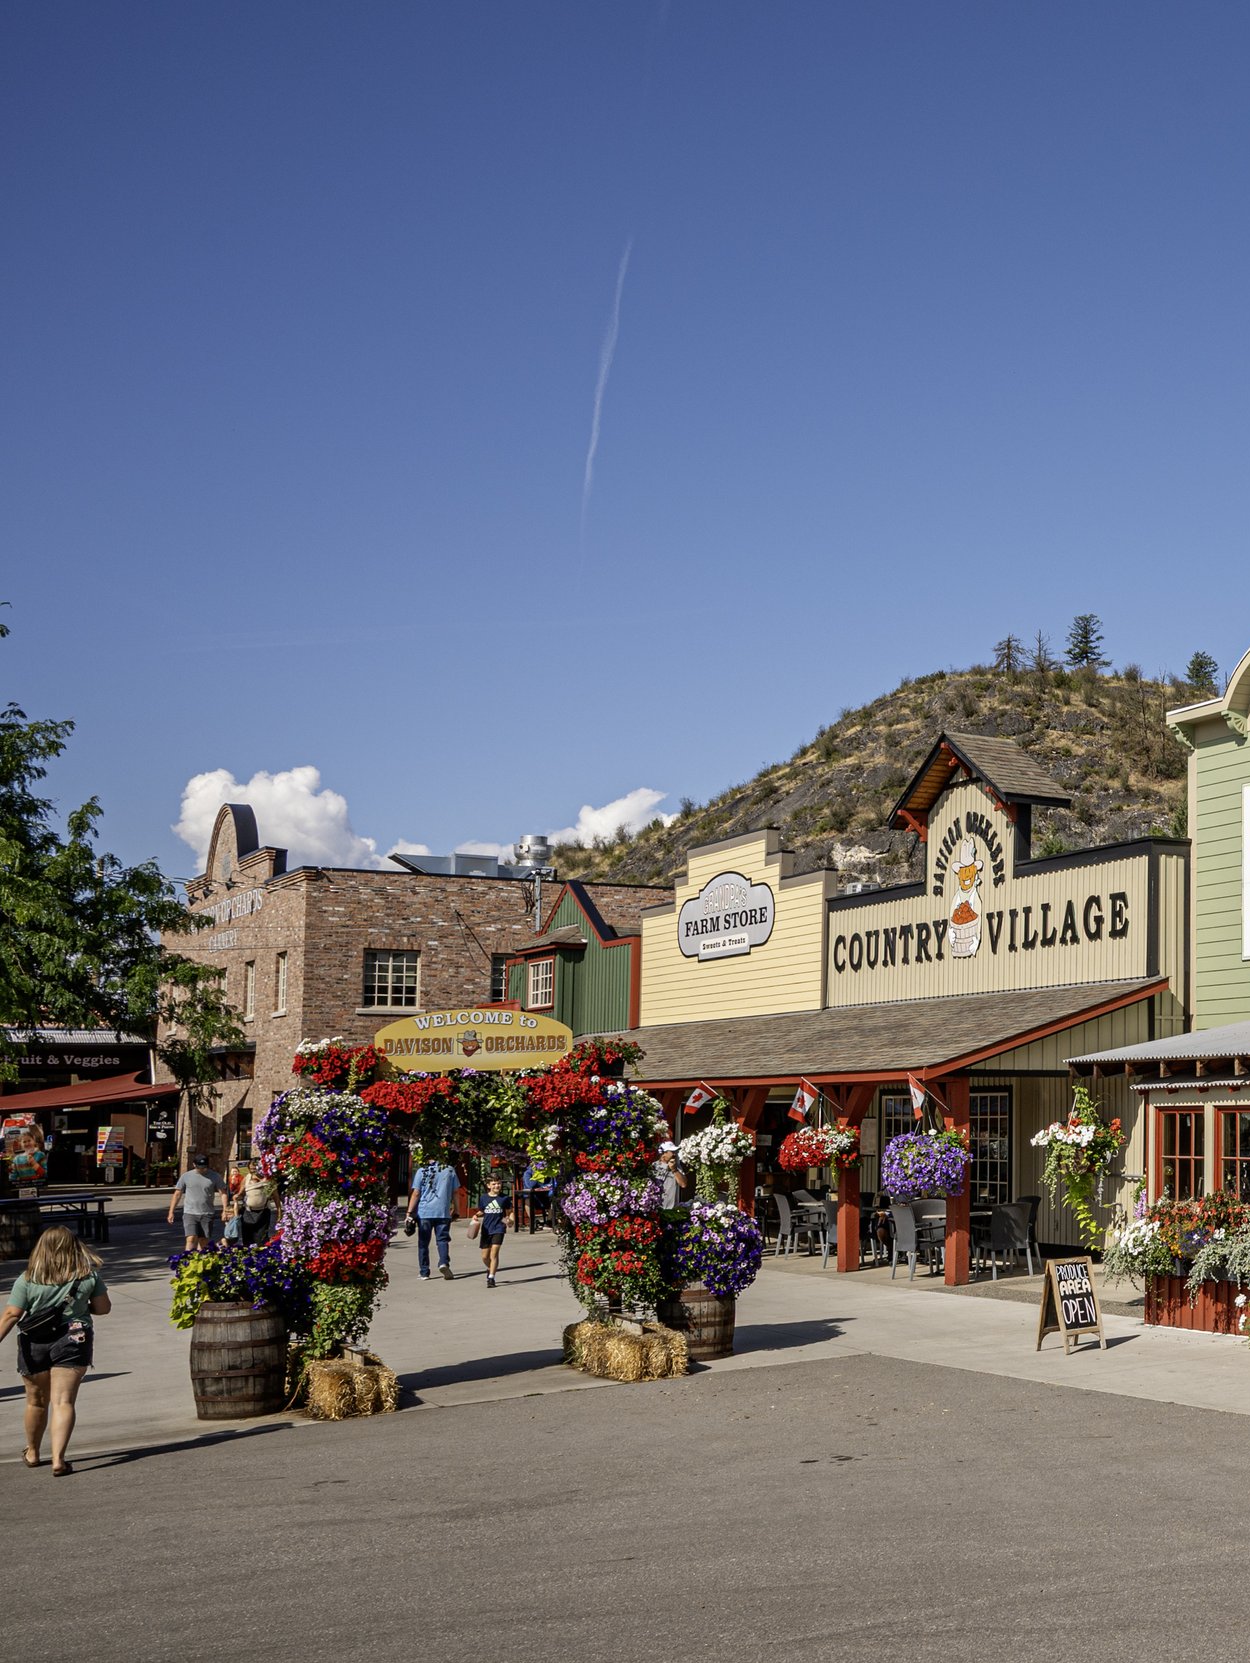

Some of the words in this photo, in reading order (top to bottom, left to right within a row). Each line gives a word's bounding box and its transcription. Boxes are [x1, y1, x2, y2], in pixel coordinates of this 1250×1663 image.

[933, 817, 963, 898] DAVISON
[966, 811, 1006, 888] ORCHARDS
[703, 882, 748, 915] GRANDPA'S
[685, 916, 720, 938] FARM
[724, 906, 768, 930] STORE
[833, 918, 948, 974] COUNTRY
[986, 891, 1130, 955] VILLAGE
[702, 941, 720, 950] Sweets
[728, 937, 746, 946] Treats
[414, 1011, 513, 1030] WELCOME
[519, 1012, 538, 1028] to
[384, 1037, 454, 1056] DAVISON
[485, 1035, 568, 1054] ORCHARDS
[47, 1054, 60, 1065] &
[63, 1054, 120, 1068] Veggies
[1055, 1263, 1089, 1281] PRODUCE
[1060, 1278, 1091, 1296] AREA
[1062, 1296, 1096, 1325] OPEN
